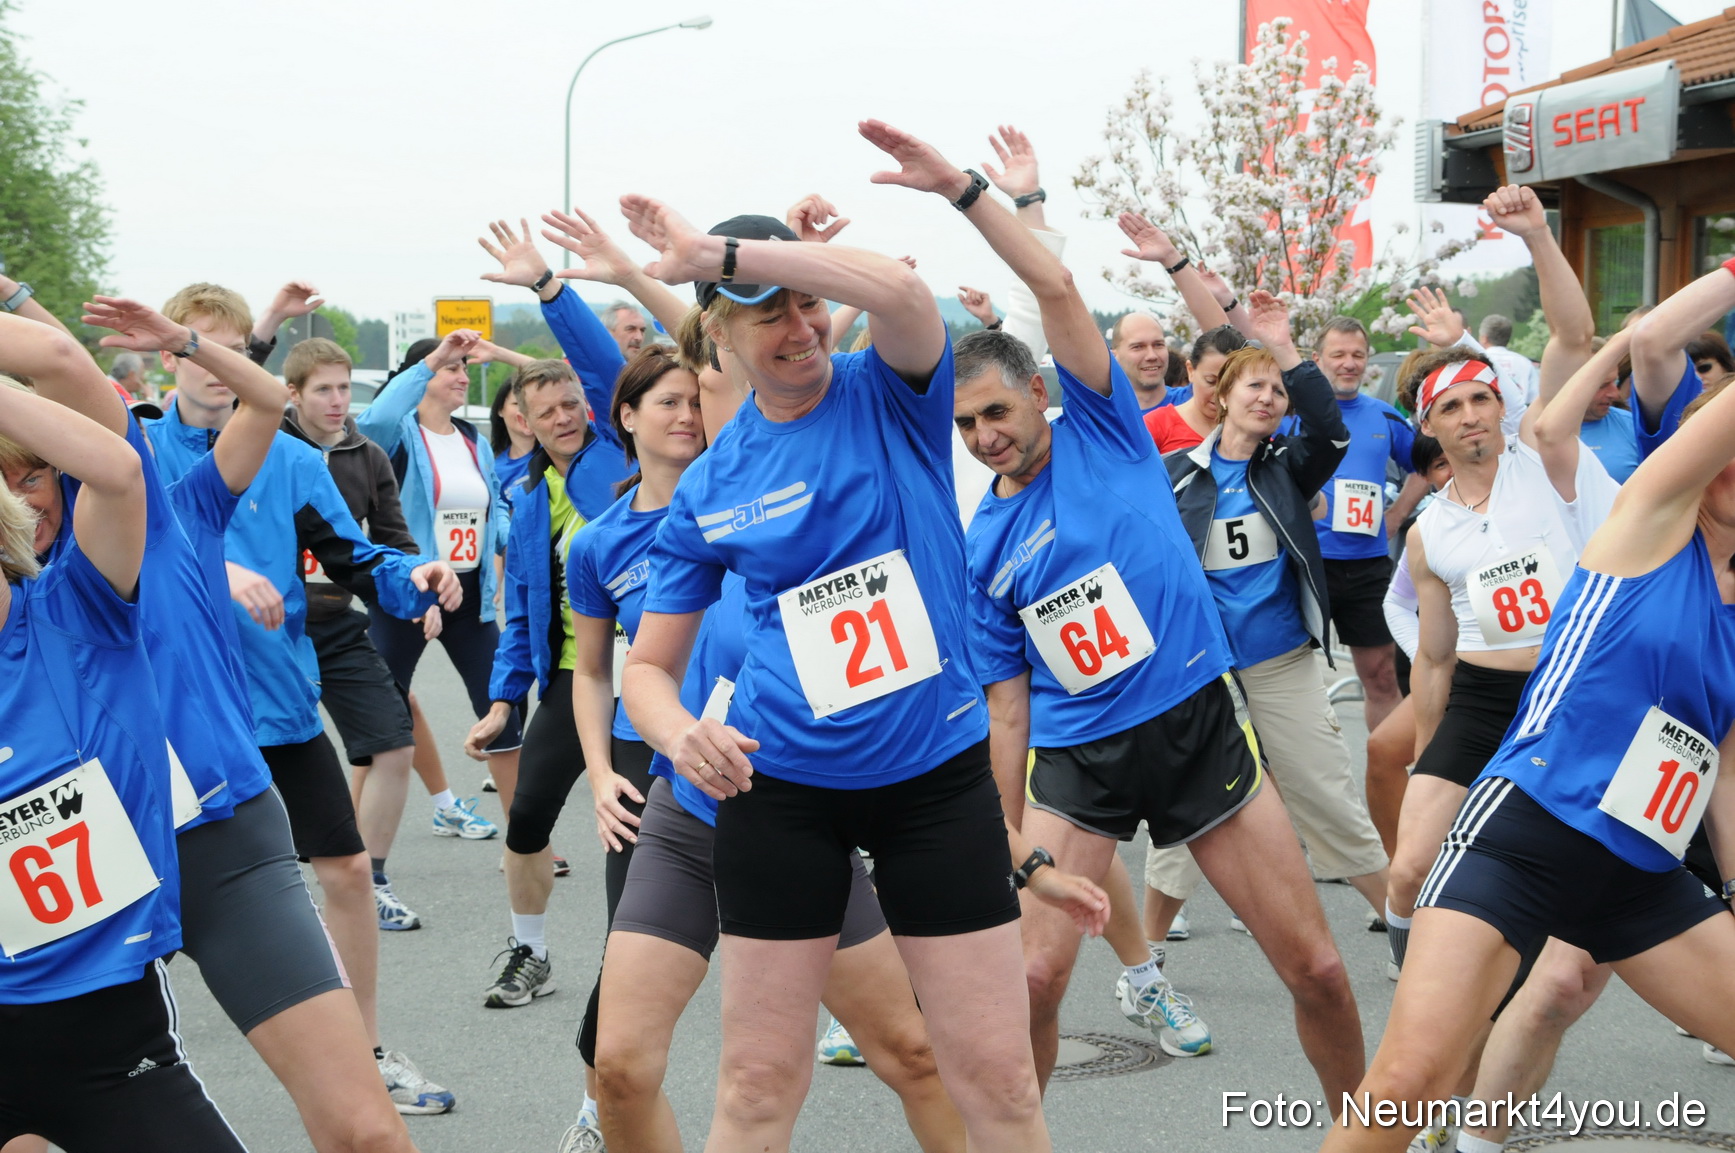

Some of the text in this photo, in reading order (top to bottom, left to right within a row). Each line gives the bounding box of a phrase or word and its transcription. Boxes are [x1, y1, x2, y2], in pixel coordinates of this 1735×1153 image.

[1552, 97, 1646, 147] SEAT
[441, 315, 486, 325] Neumarkt
[443, 512, 469, 520] MEYER
[1347, 497, 1374, 529] 54
[449, 528, 477, 561] 23
[1225, 519, 1249, 560] 5
[1479, 561, 1520, 582] MEYER
[1481, 570, 1523, 588] WERBUNG
[798, 573, 860, 607] MEYER
[801, 587, 863, 617] WERBUNG
[1035, 588, 1081, 619] MEYER
[1492, 578, 1551, 633] 83
[1040, 598, 1085, 626] WERBUNG
[831, 598, 909, 689] 21
[1060, 605, 1130, 676] 64
[1658, 733, 1699, 766] WERBUNG
[1661, 721, 1705, 757] MEYER
[1643, 759, 1699, 834] 10
[9, 820, 104, 925] 67
